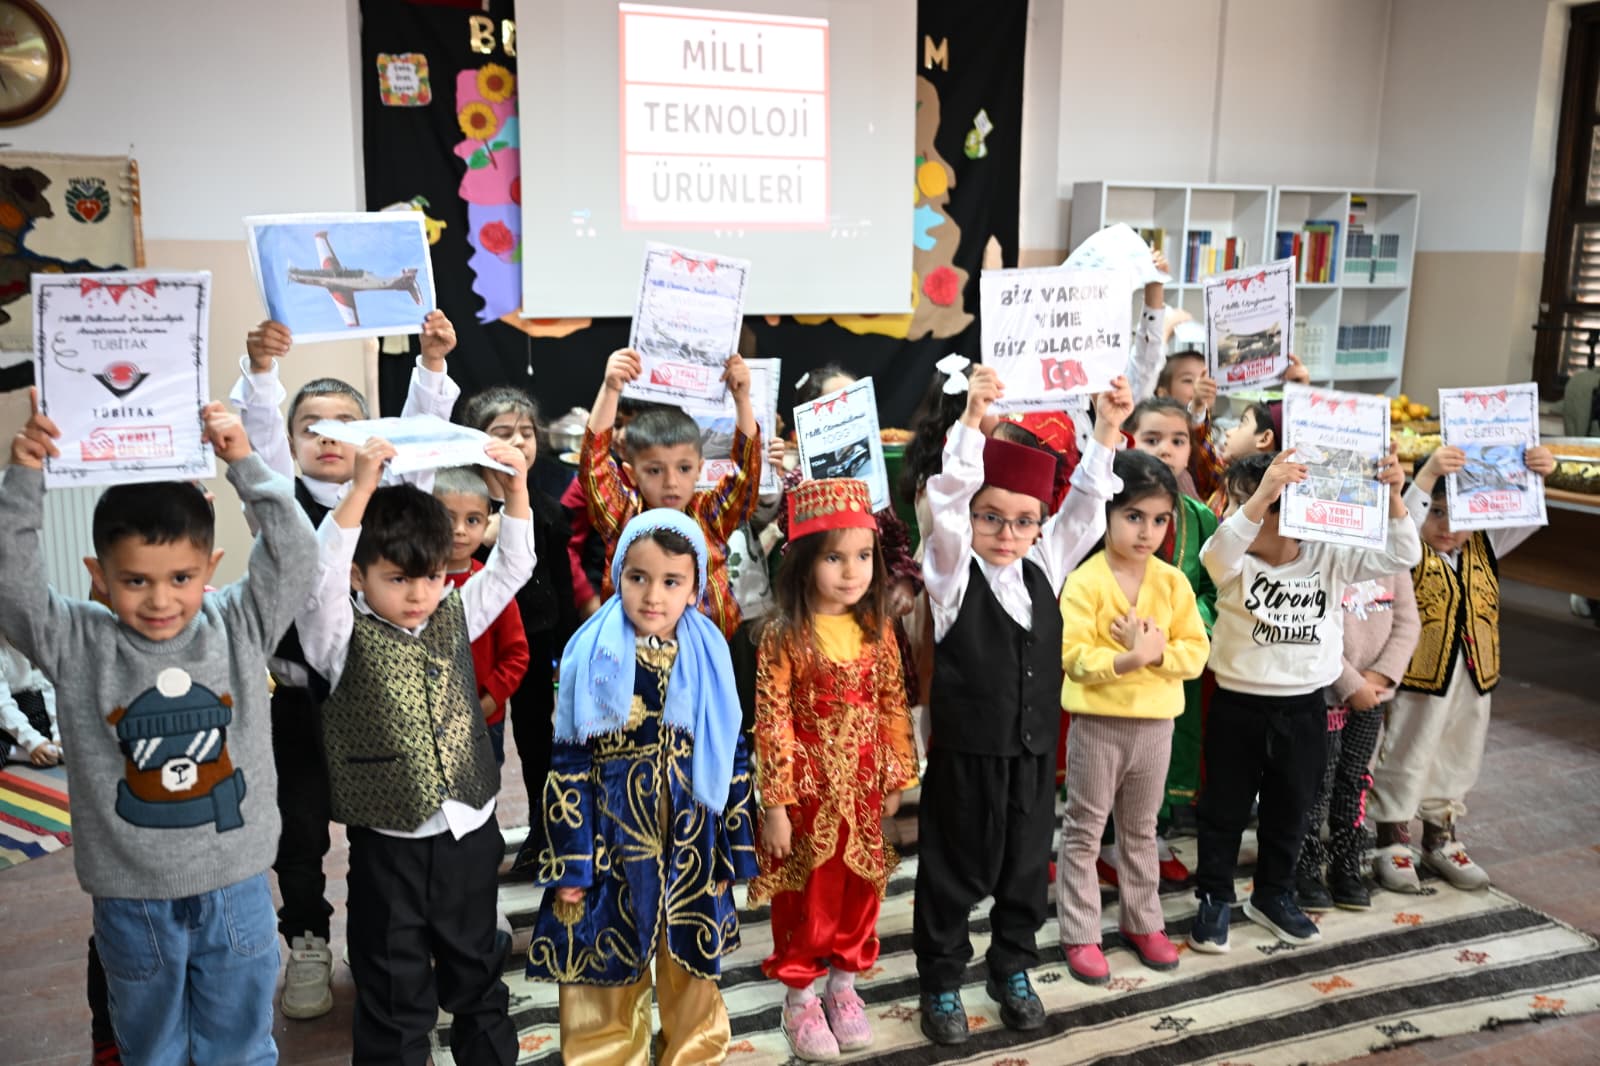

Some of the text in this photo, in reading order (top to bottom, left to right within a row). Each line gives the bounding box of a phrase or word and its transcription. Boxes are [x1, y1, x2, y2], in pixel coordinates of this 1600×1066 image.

[683, 29, 763, 74] MİLLİ
[644, 97, 809, 138] TEKNOLOJİ
[652, 160, 803, 204] ÜRÜNLERİ
[1001, 284, 1033, 306] BİZ
[92, 337, 148, 350] TÜBİTAK
[993, 329, 1121, 357] BİZ OLACAĞIZ
[93, 406, 154, 418] TÜBİTAK
[1245, 577, 1326, 618] Strong
[1255, 622, 1321, 643] MOTHER
